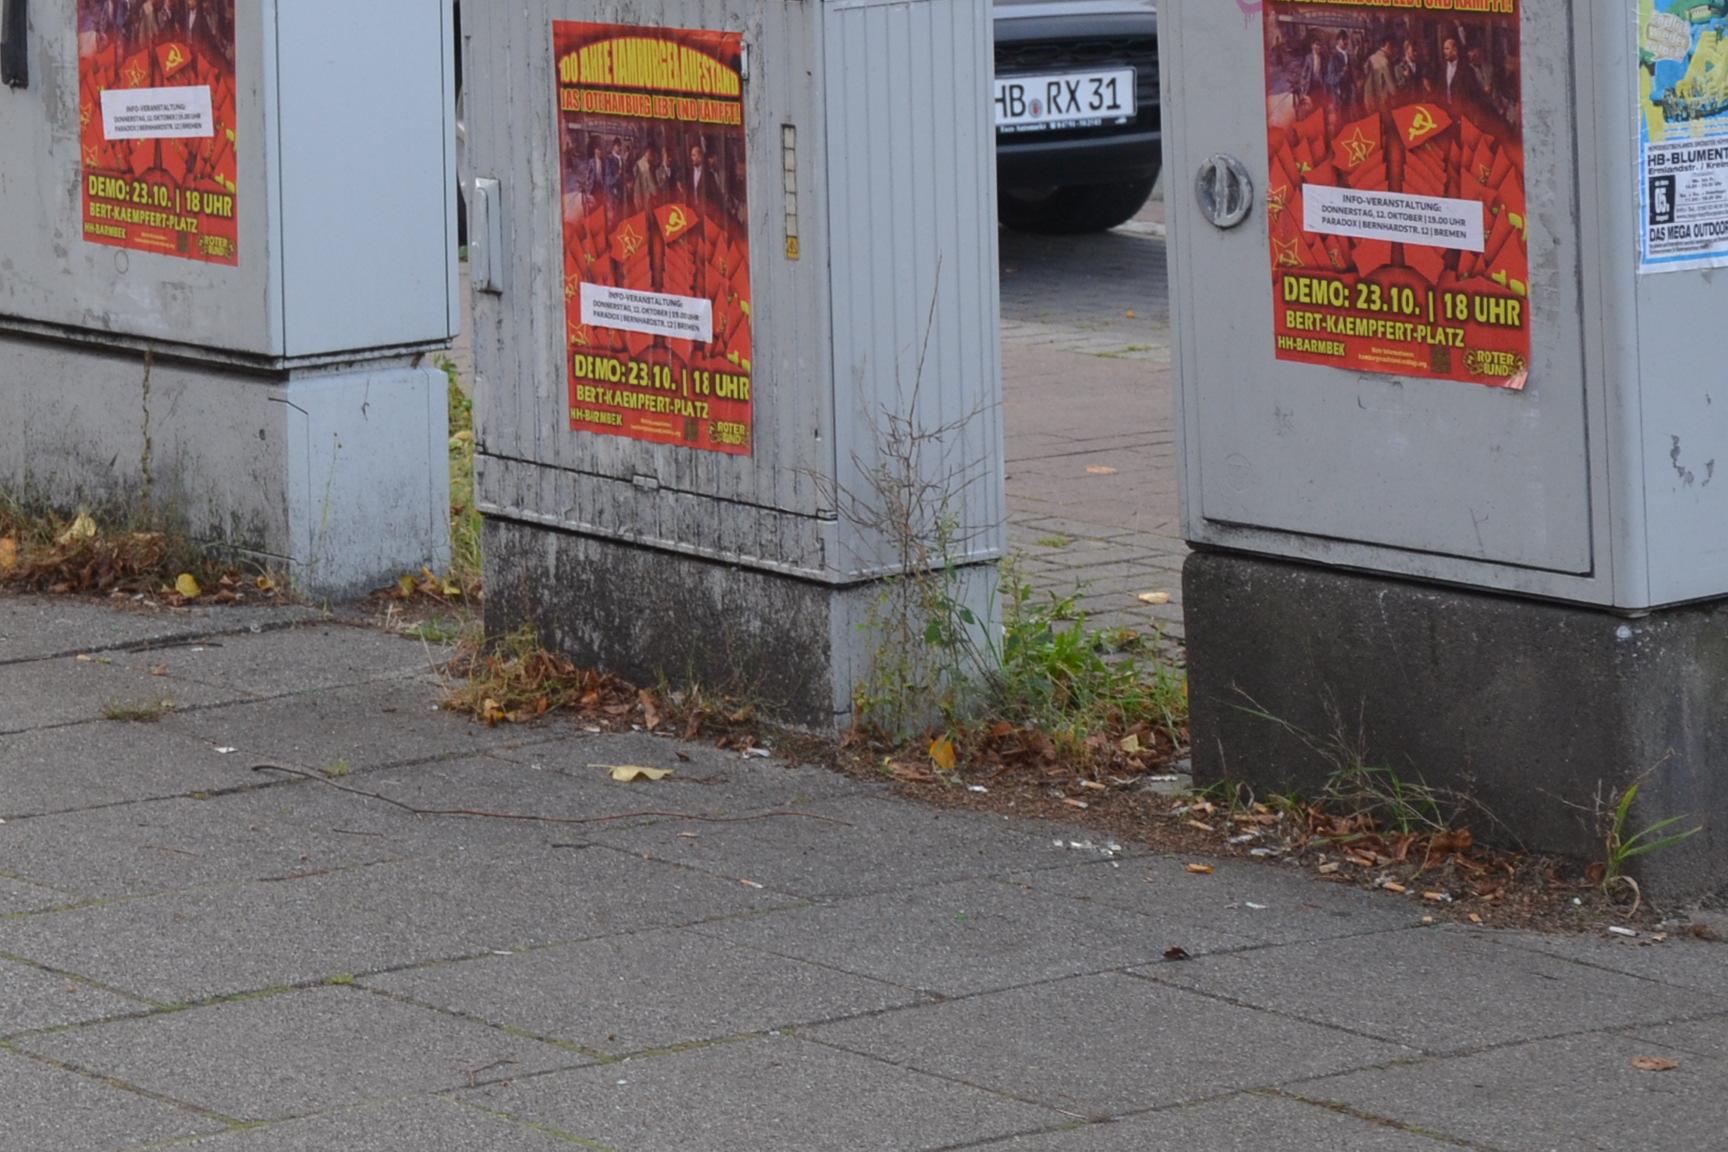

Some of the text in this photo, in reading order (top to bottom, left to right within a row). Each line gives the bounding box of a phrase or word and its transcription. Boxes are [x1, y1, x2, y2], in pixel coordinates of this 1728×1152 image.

[680, 45, 741, 97] AUFSTAND
[995, 77, 1121, 119] HB RX 31
[88, 175, 130, 201] DEMO:
[132, 181, 172, 208] 23.10.
[185, 189, 201, 213] 18
[203, 192, 233, 218] UHR
[1342, 194, 1442, 213] INFO-VERANSTALTUNG:
[89, 201, 199, 234] BERT-KAEMPFERT-PLATZ
[1321, 204, 1375, 219] DONNERSTAG,
[1376, 210, 1387, 220] 12.
[1387, 211, 1423, 223] OKTOBER
[1449, 217, 1466, 227] UHR
[1321, 216, 1357, 229] PARADOX
[1363, 220, 1420, 235] BERNHARDSTR.
[1421, 226, 1429, 235] 12
[1434, 228, 1467, 239] BREMEN
[83, 222, 127, 239] HH-BARMBEK
[1667, 224, 1692, 240] MEGA
[608, 291, 684, 308] INFO-VERANSTALTUNG:
[1283, 276, 1350, 308] DEMO:
[1356, 283, 1421, 315] 23.10.
[1444, 293, 1469, 321] 18
[1474, 296, 1521, 326] UHR
[1285, 310, 1465, 347] BERT-KAEMPFERT-PLATZ
[1277, 335, 1345, 356] HH-BARMBEK
[1477, 350, 1514, 365] ROTER
[574, 353, 626, 384] DEMO:
[628, 361, 677, 391] 23.10.
[693, 370, 710, 396] 18
[715, 373, 750, 401] UHR
[576, 384, 709, 419] BERT-KAEMPFERT-PLATZ
